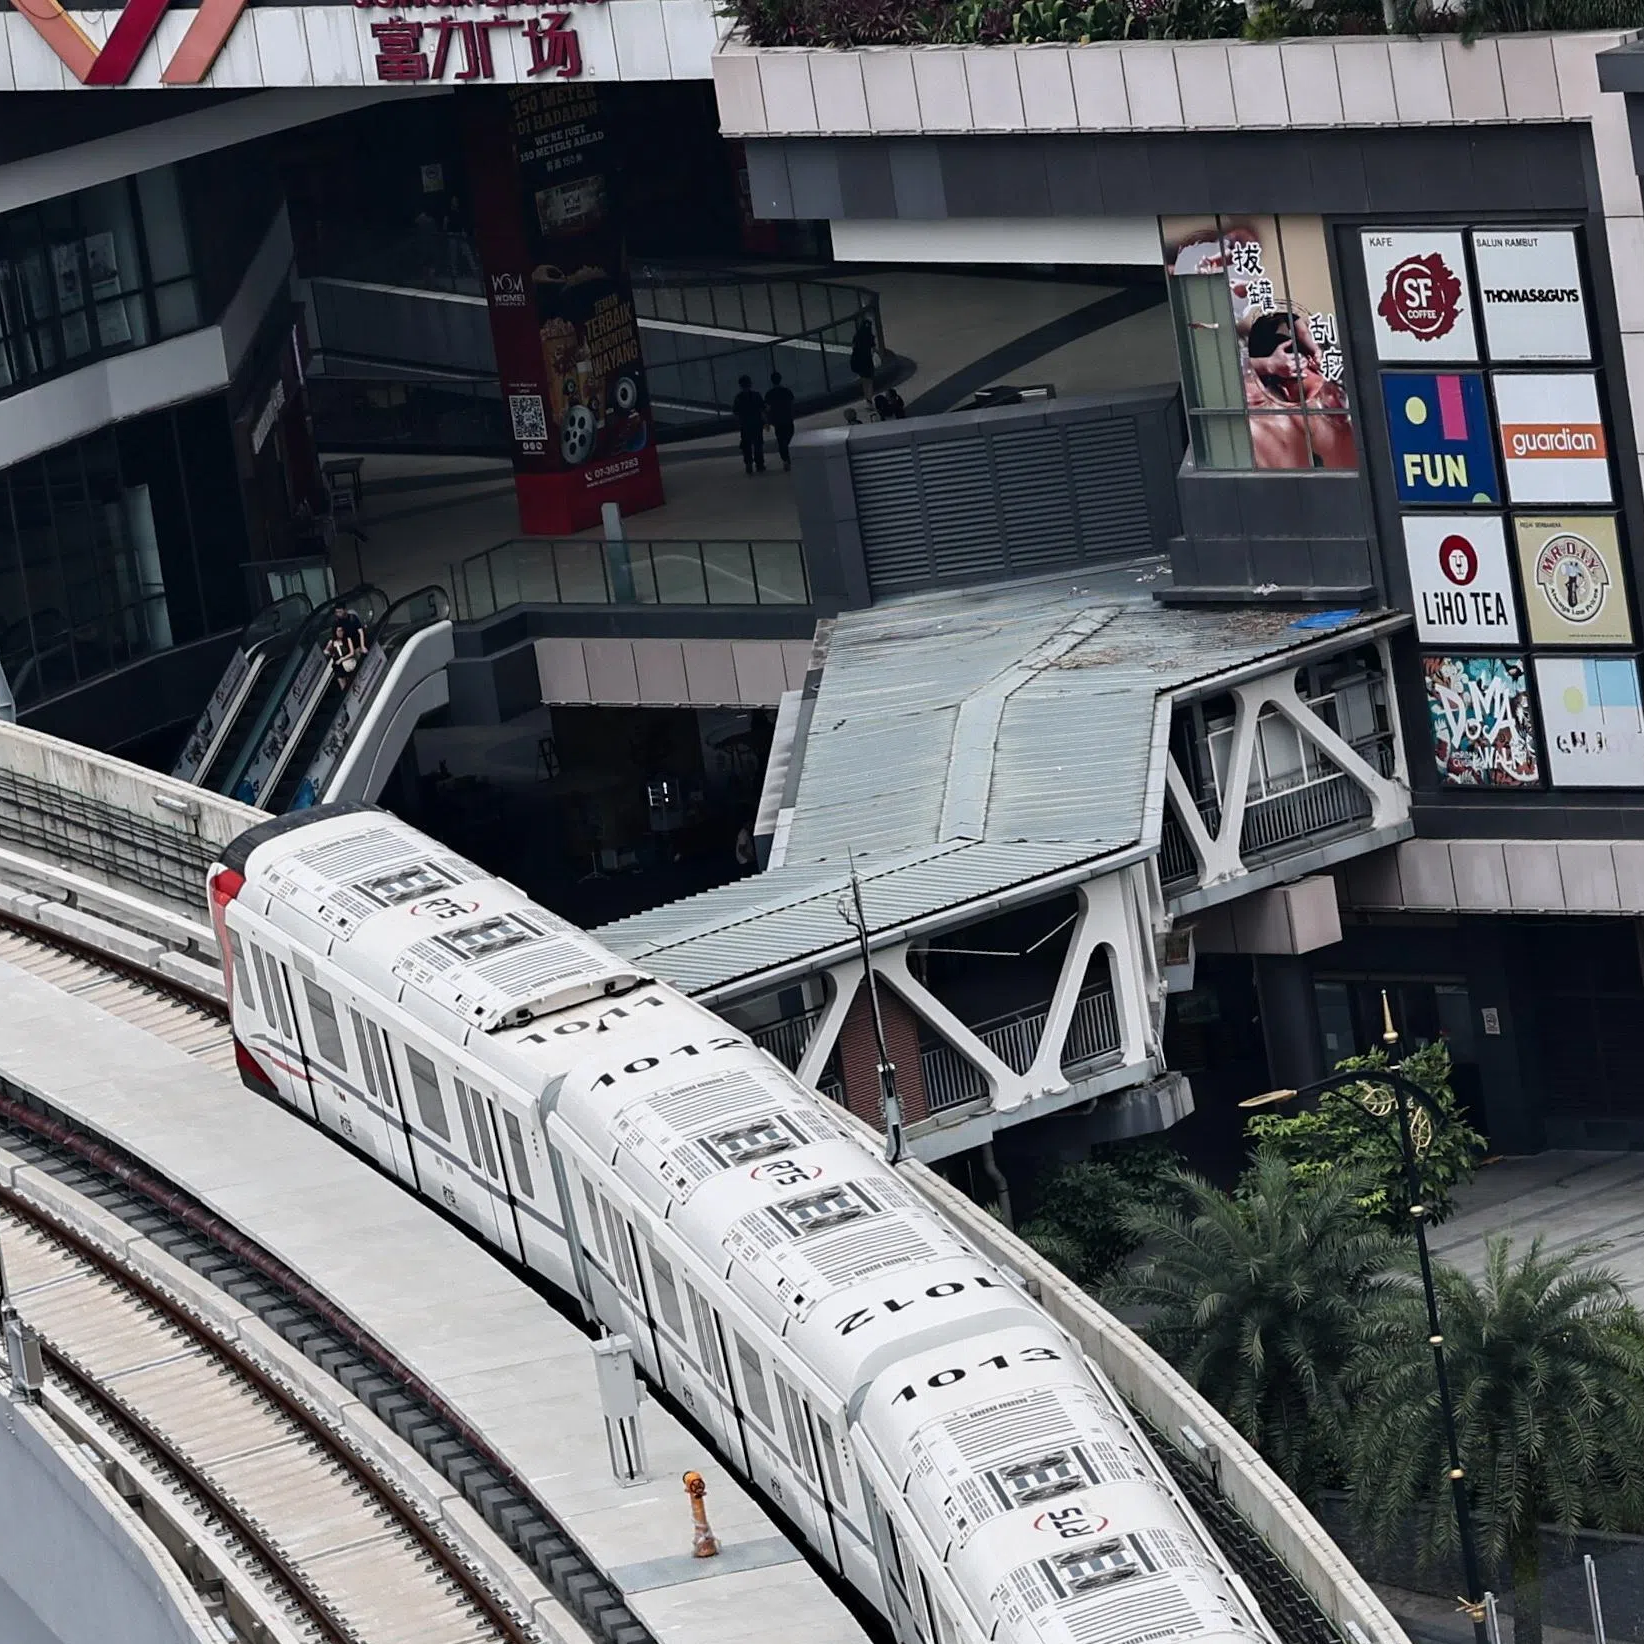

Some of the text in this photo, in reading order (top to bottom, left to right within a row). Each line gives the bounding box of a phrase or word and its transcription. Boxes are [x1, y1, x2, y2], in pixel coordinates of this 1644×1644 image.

[371, 12, 583, 80] 富力广场
[1369, 237, 1393, 247] KAFE
[1476, 237, 1539, 247] SALUN RAMBUT
[1232, 242, 1276, 312] 拔罐
[1403, 277, 1433, 308] SF
[1483, 288, 1579, 303] THOMAS&GUYS
[1407, 309, 1438, 320] COFFEE
[1512, 428, 1597, 456] guardian
[1403, 454, 1469, 487] FUN
[1469, 592, 1509, 626] TEA
[422, 896, 469, 920] RTS
[516, 996, 665, 1045] 1011
[590, 1037, 752, 1091] 1012
[763, 1159, 813, 1187] RTS
[834, 1275, 1007, 1336] 1012
[891, 1347, 1063, 1406] 1013
[1047, 1506, 1095, 1539] RTS
